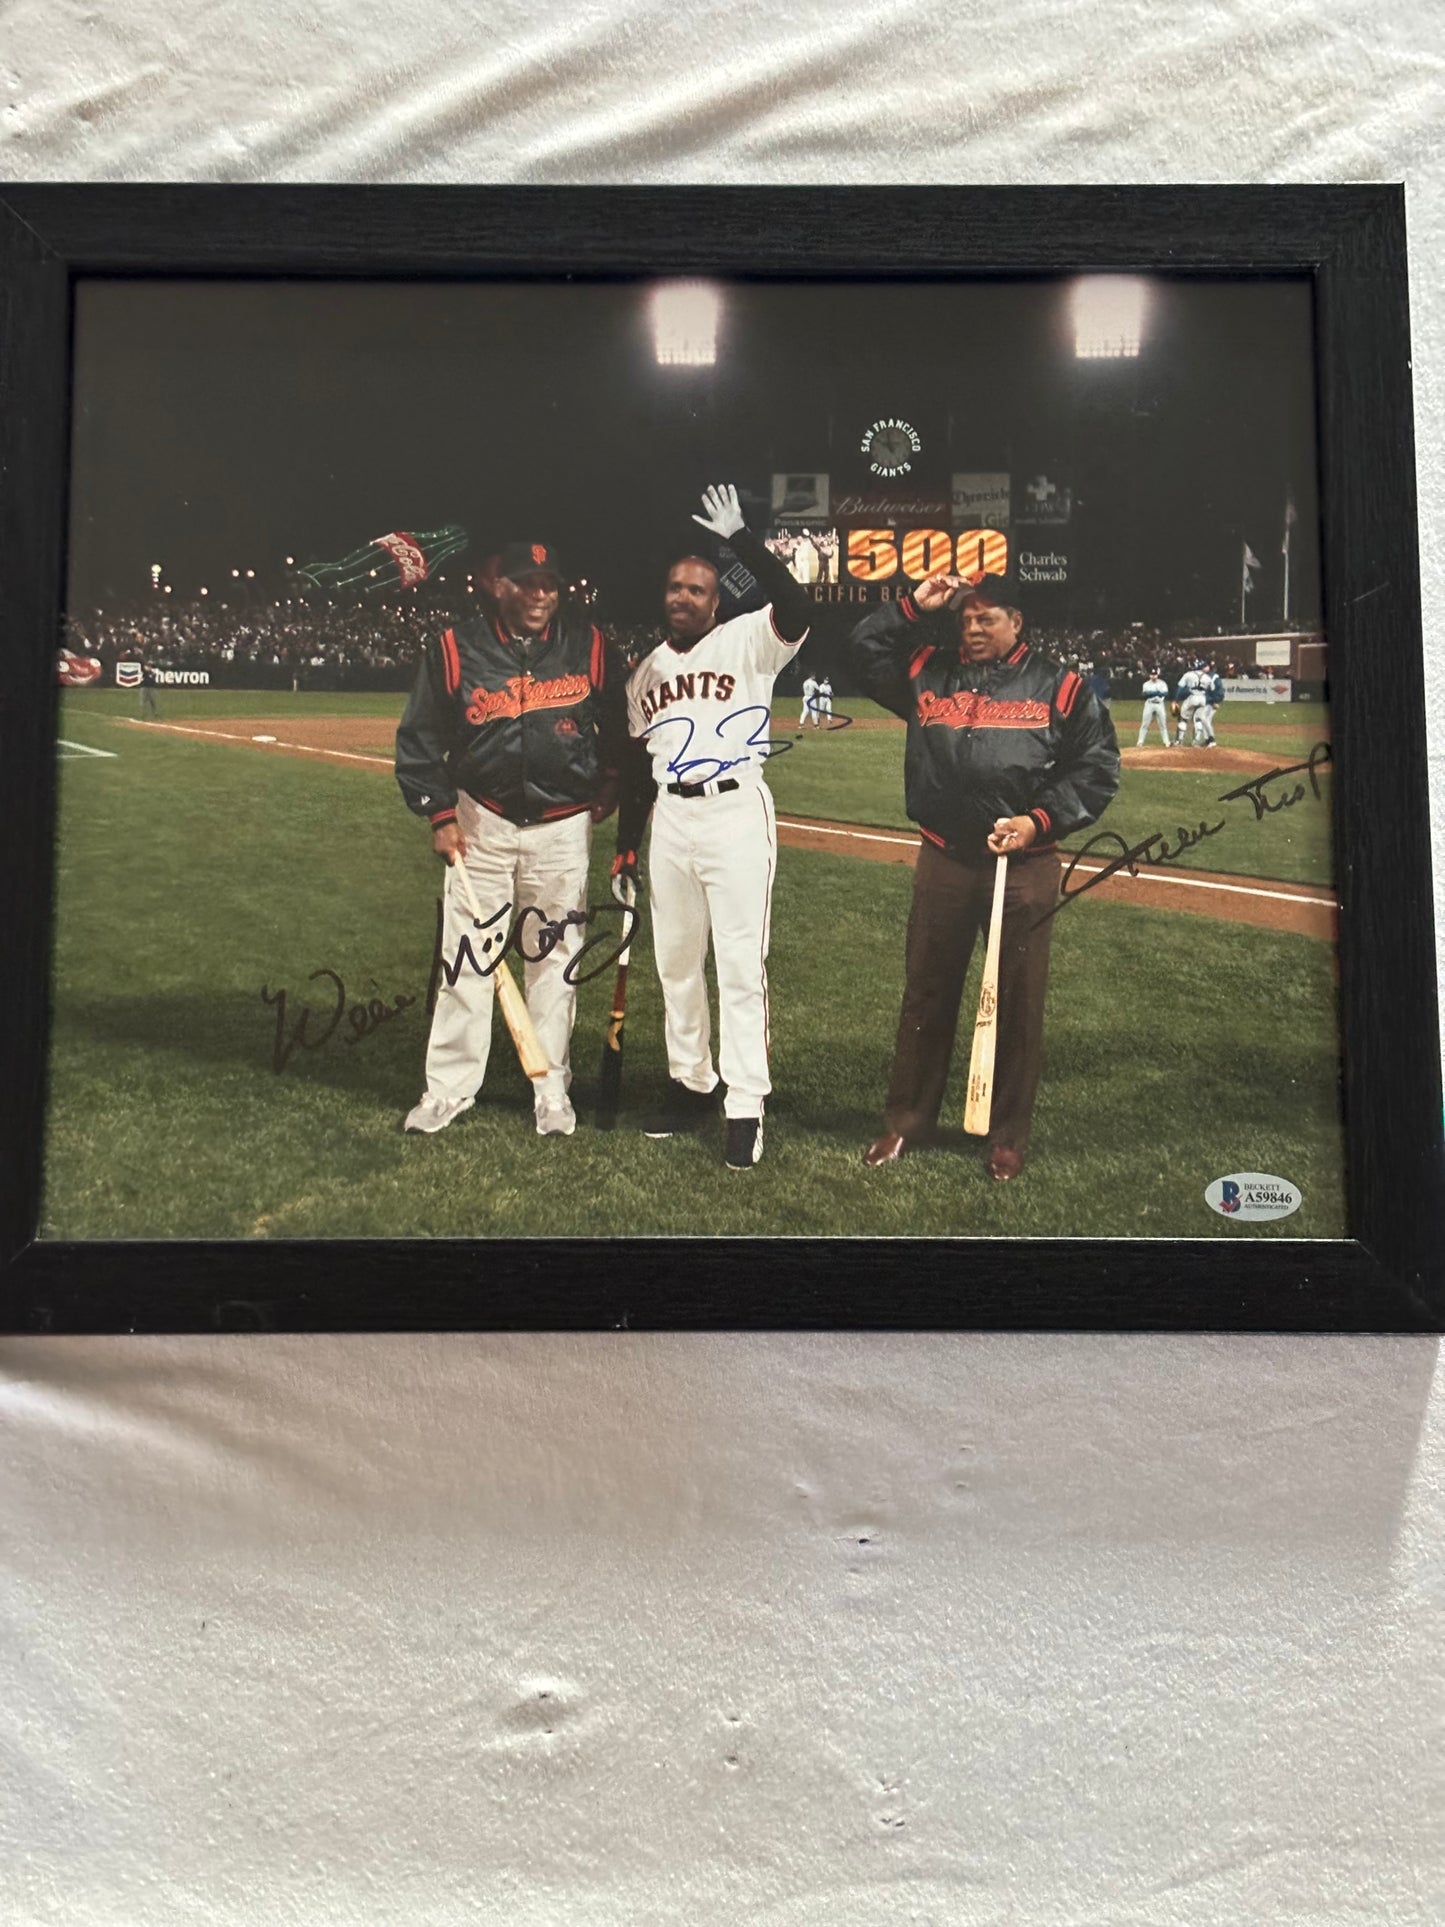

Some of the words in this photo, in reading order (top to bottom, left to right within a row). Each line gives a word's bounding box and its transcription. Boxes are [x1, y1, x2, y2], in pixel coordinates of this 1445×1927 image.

[860, 429, 875, 453] SAN
[872, 418, 921, 452] FRANCISCO
[870, 462, 912, 477] GIANTS
[835, 496, 946, 515] Budweiser
[774, 518, 827, 527] Panasonic
[847, 529, 1008, 581] 500
[1019, 552, 1067, 566] Charles
[1019, 567, 1067, 581] Schwab
[803, 586, 867, 602] CIFIC
[154, 668, 210, 685] hevron
[641, 671, 736, 725] GIANTS
[1244, 1183, 1280, 1191] BECKETT
[1244, 1191, 1293, 1204] A59846
